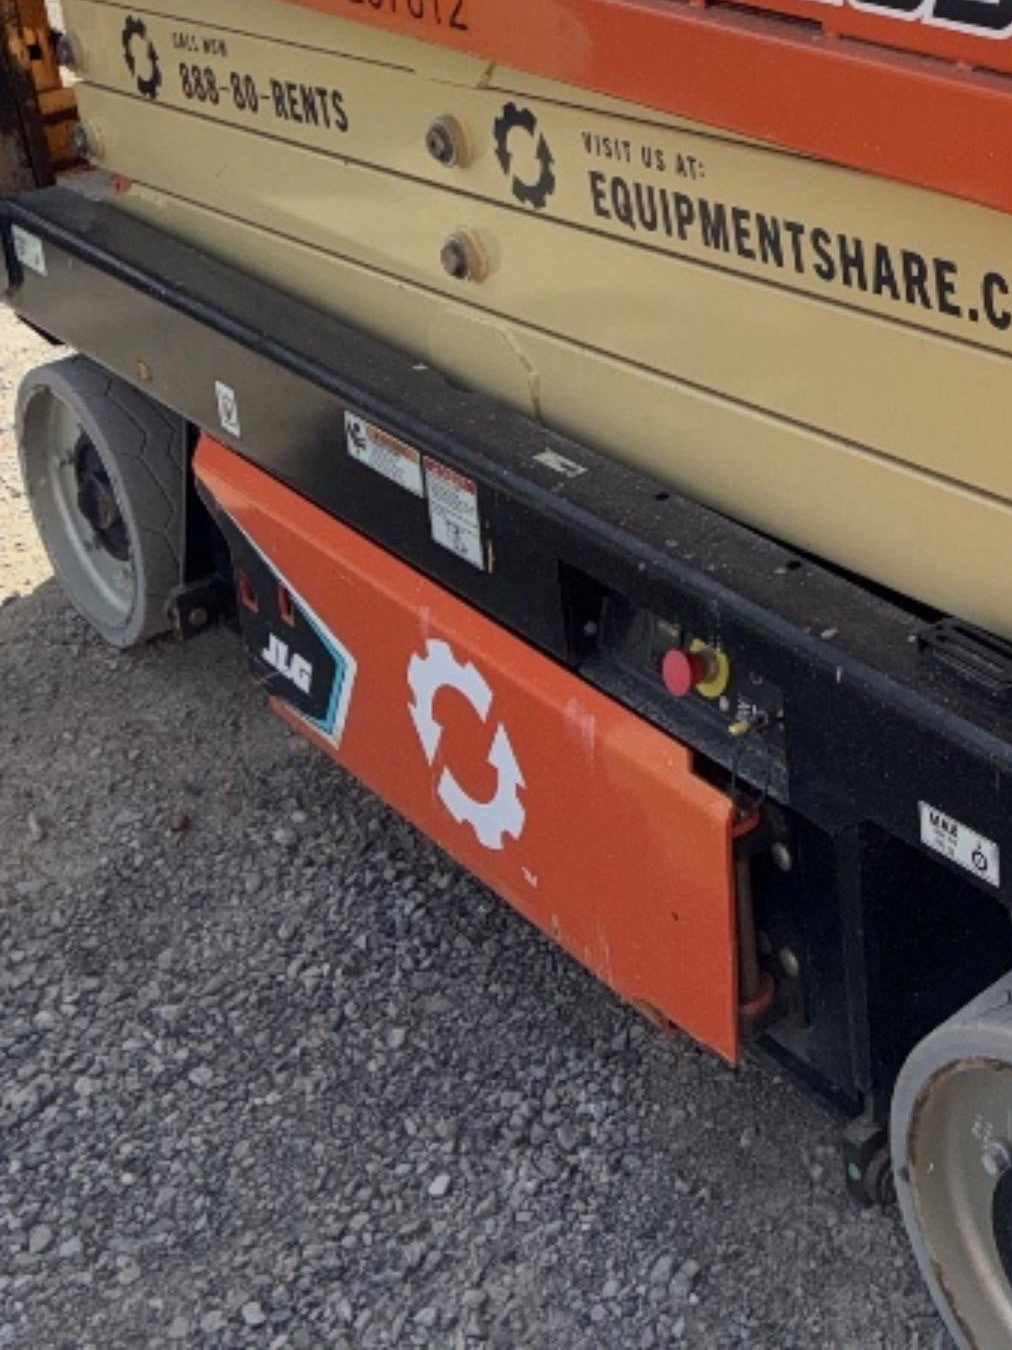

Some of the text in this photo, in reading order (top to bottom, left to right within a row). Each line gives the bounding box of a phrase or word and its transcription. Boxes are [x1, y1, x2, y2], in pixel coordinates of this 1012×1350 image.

[179, 62, 348, 132] 888-80-RENTS
[580, 131, 705, 180] VISIT US AT:
[262, 632, 313, 694] JLG
